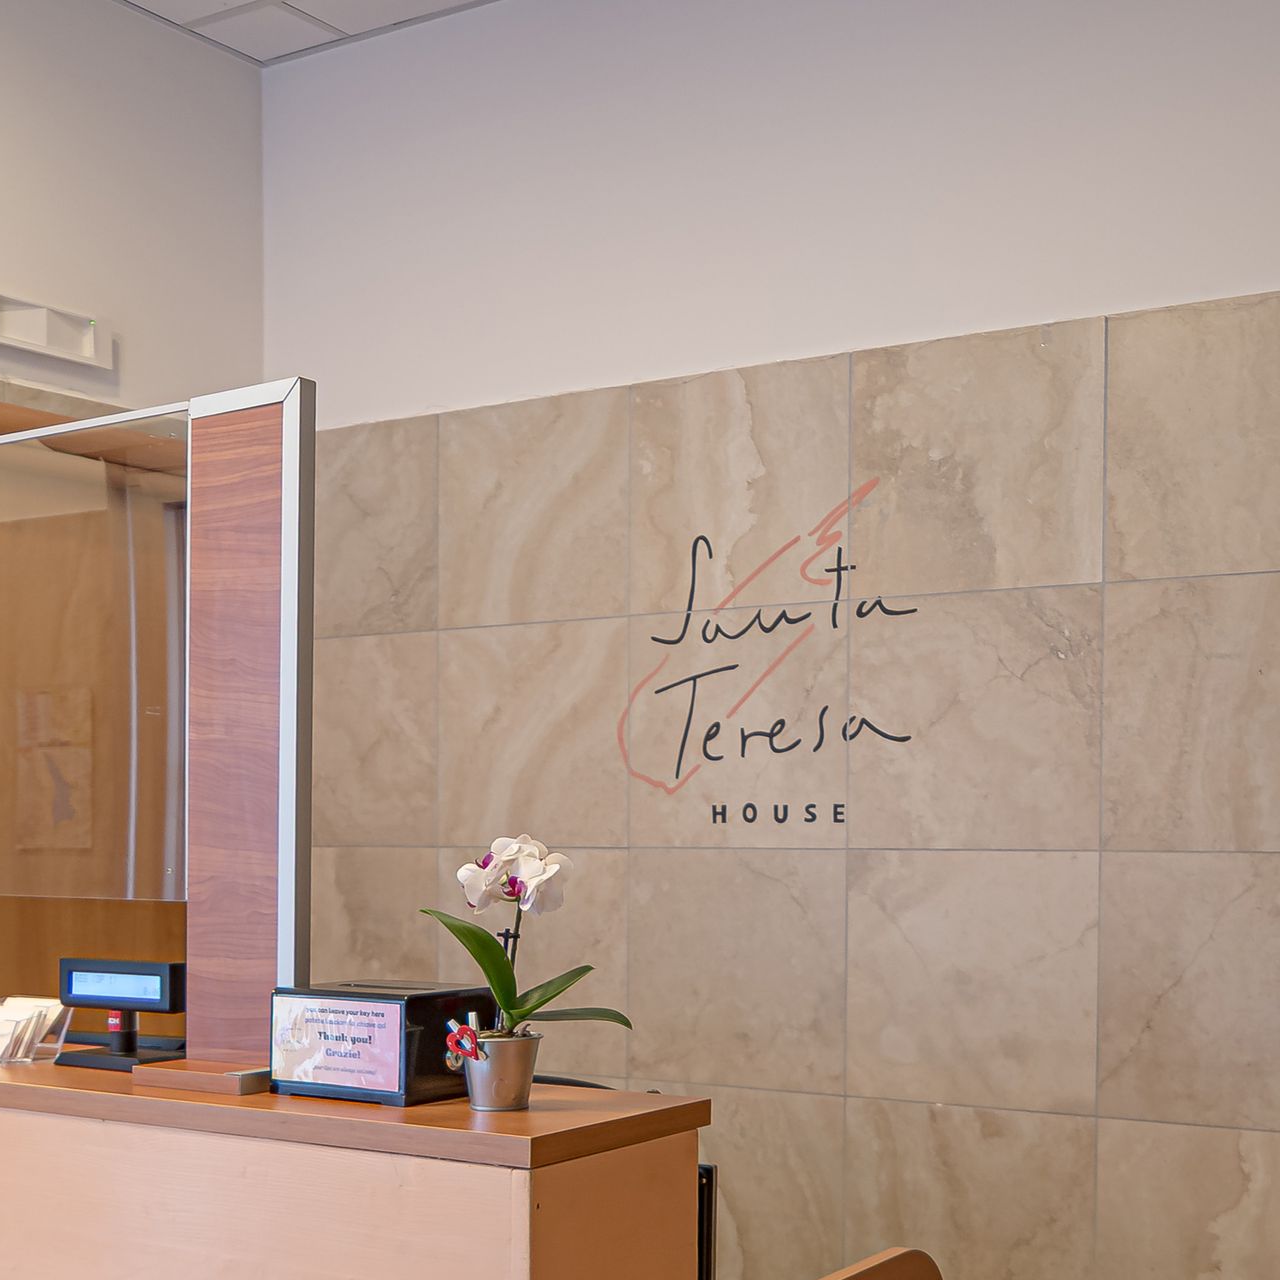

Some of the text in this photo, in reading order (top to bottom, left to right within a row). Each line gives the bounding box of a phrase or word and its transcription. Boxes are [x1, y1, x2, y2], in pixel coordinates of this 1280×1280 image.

[651, 535, 917, 645] Santa
[654, 664, 912, 779] Teresa
[712, 803, 845, 823] HOUSE
[318, 1032, 372, 1045] Thank you!
[326, 1048, 361, 1058] Grazie!
